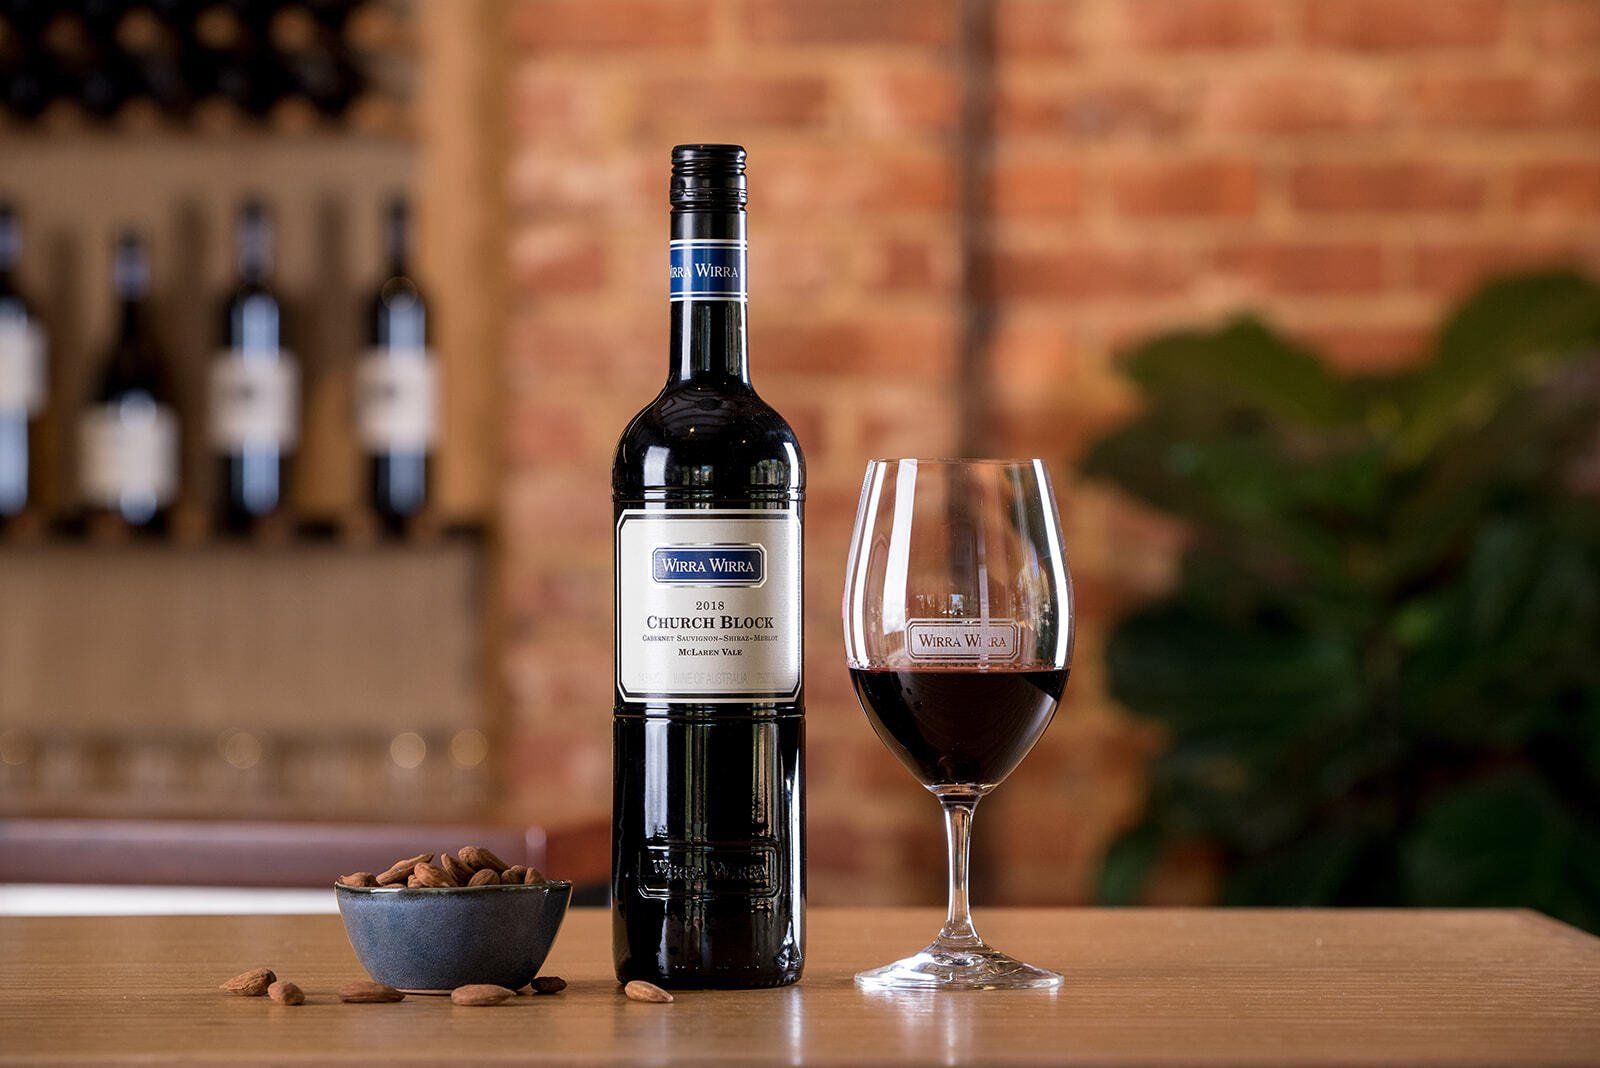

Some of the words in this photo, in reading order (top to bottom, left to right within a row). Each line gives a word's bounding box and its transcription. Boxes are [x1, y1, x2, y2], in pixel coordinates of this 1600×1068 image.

[694, 262, 739, 278] WIRRA
[661, 557, 706, 573] WIRRA
[708, 557, 755, 573] WIRRA
[695, 600, 725, 611] 2018
[646, 615, 715, 629] CHURCH
[719, 615, 775, 629] BLOCK
[918, 633, 962, 648] WIRRA
[964, 633, 1008, 648] WIRA
[721, 648, 743, 657] VALE
